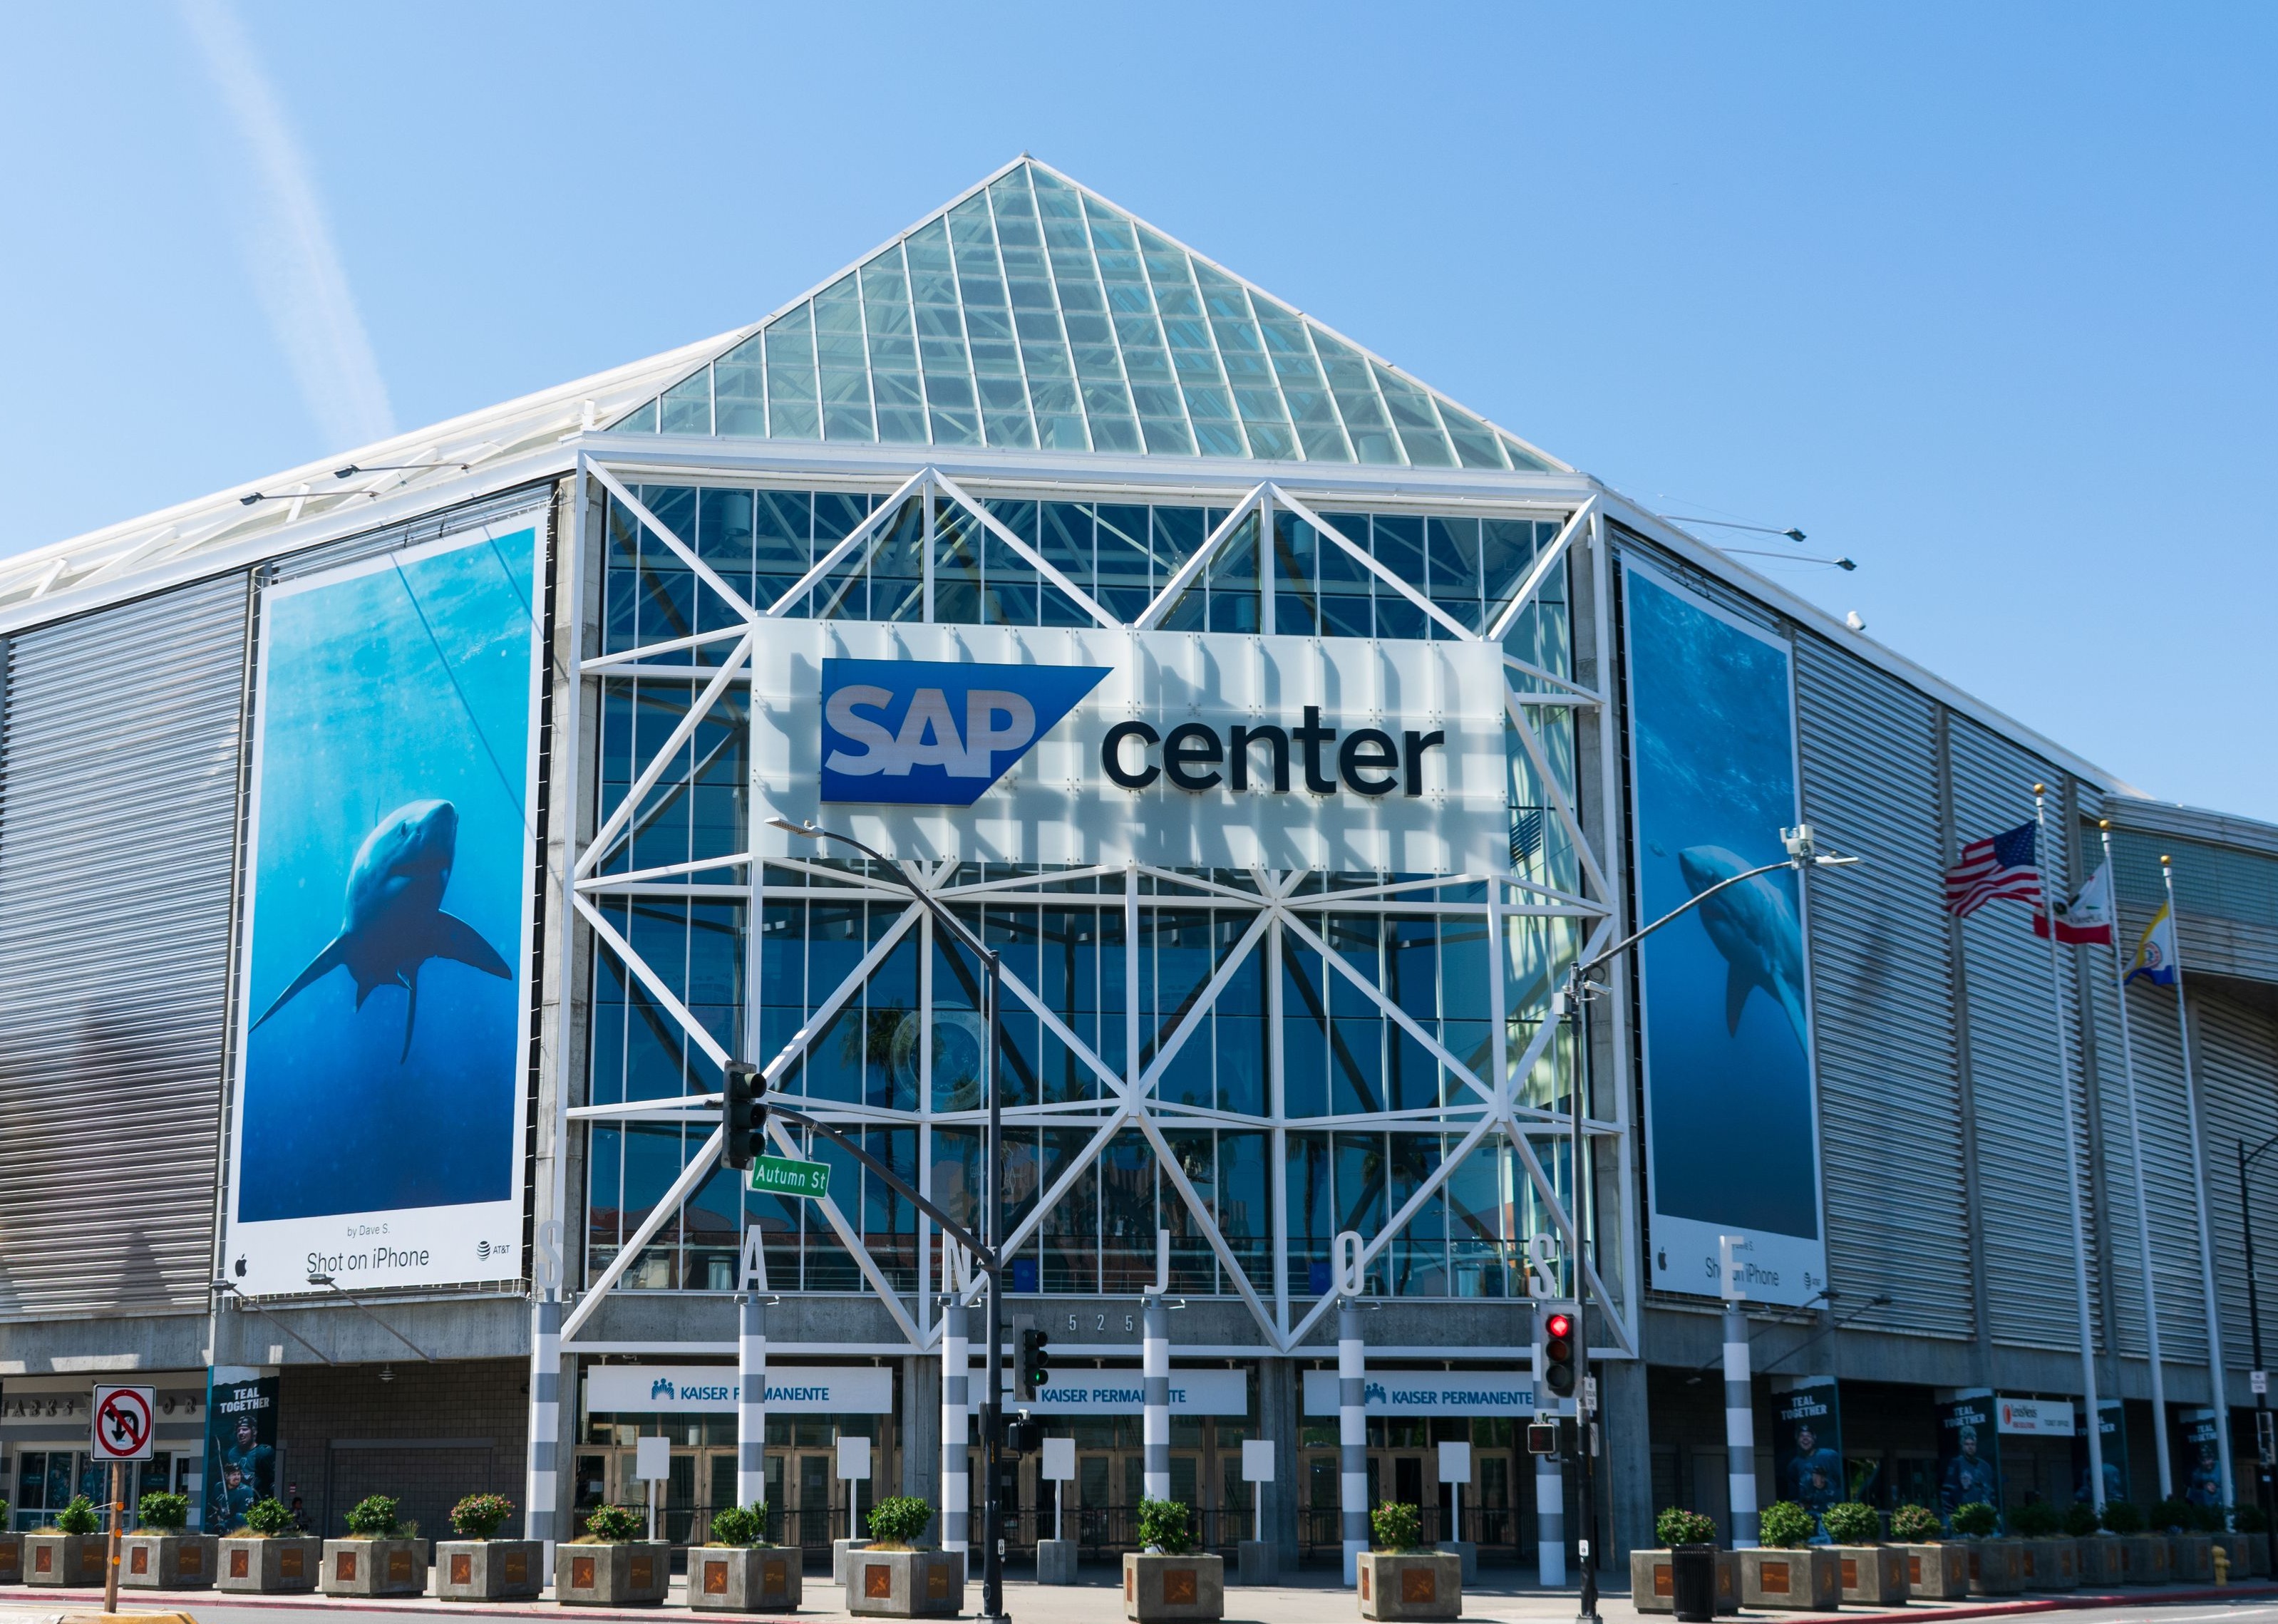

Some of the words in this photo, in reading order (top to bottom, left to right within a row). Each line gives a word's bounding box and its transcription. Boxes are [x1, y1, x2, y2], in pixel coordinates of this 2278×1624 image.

[825, 684, 1036, 778] SAP
[1101, 705, 1445, 799] center
[756, 1164, 805, 1187] Autumn
[811, 1171, 826, 1190] St
[347, 1226, 356, 1238] by
[359, 1225, 380, 1236] Dave
[382, 1223, 391, 1234] S.
[493, 1245, 510, 1254] AT&T
[306, 1252, 344, 1273] Shot
[348, 1254, 367, 1271] on
[373, 1247, 429, 1268] iPhone
[1705, 1256, 1722, 1278] Sh
[1745, 1263, 1780, 1287] iPhone
[234, 1387, 259, 1400] TEAL
[681, 1387, 728, 1400] KAISER
[733, 1387, 830, 1401] PMANENTE
[1041, 1389, 1088, 1402] KAISER
[1093, 1389, 1187, 1403] PERMATE
[1392, 1391, 1438, 1405] KAISER
[1442, 1391, 1533, 1405] PERMANENTE
[220, 1397, 270, 1414] TOGETHER
[1790, 1395, 1815, 1407] TEAL
[1780, 1404, 1828, 1421] TOGETHER
[1953, 1405, 1975, 1417] TEAL
[1943, 1413, 1986, 1429] TOGETHER
[2195, 1424, 2214, 1434] TEAL
